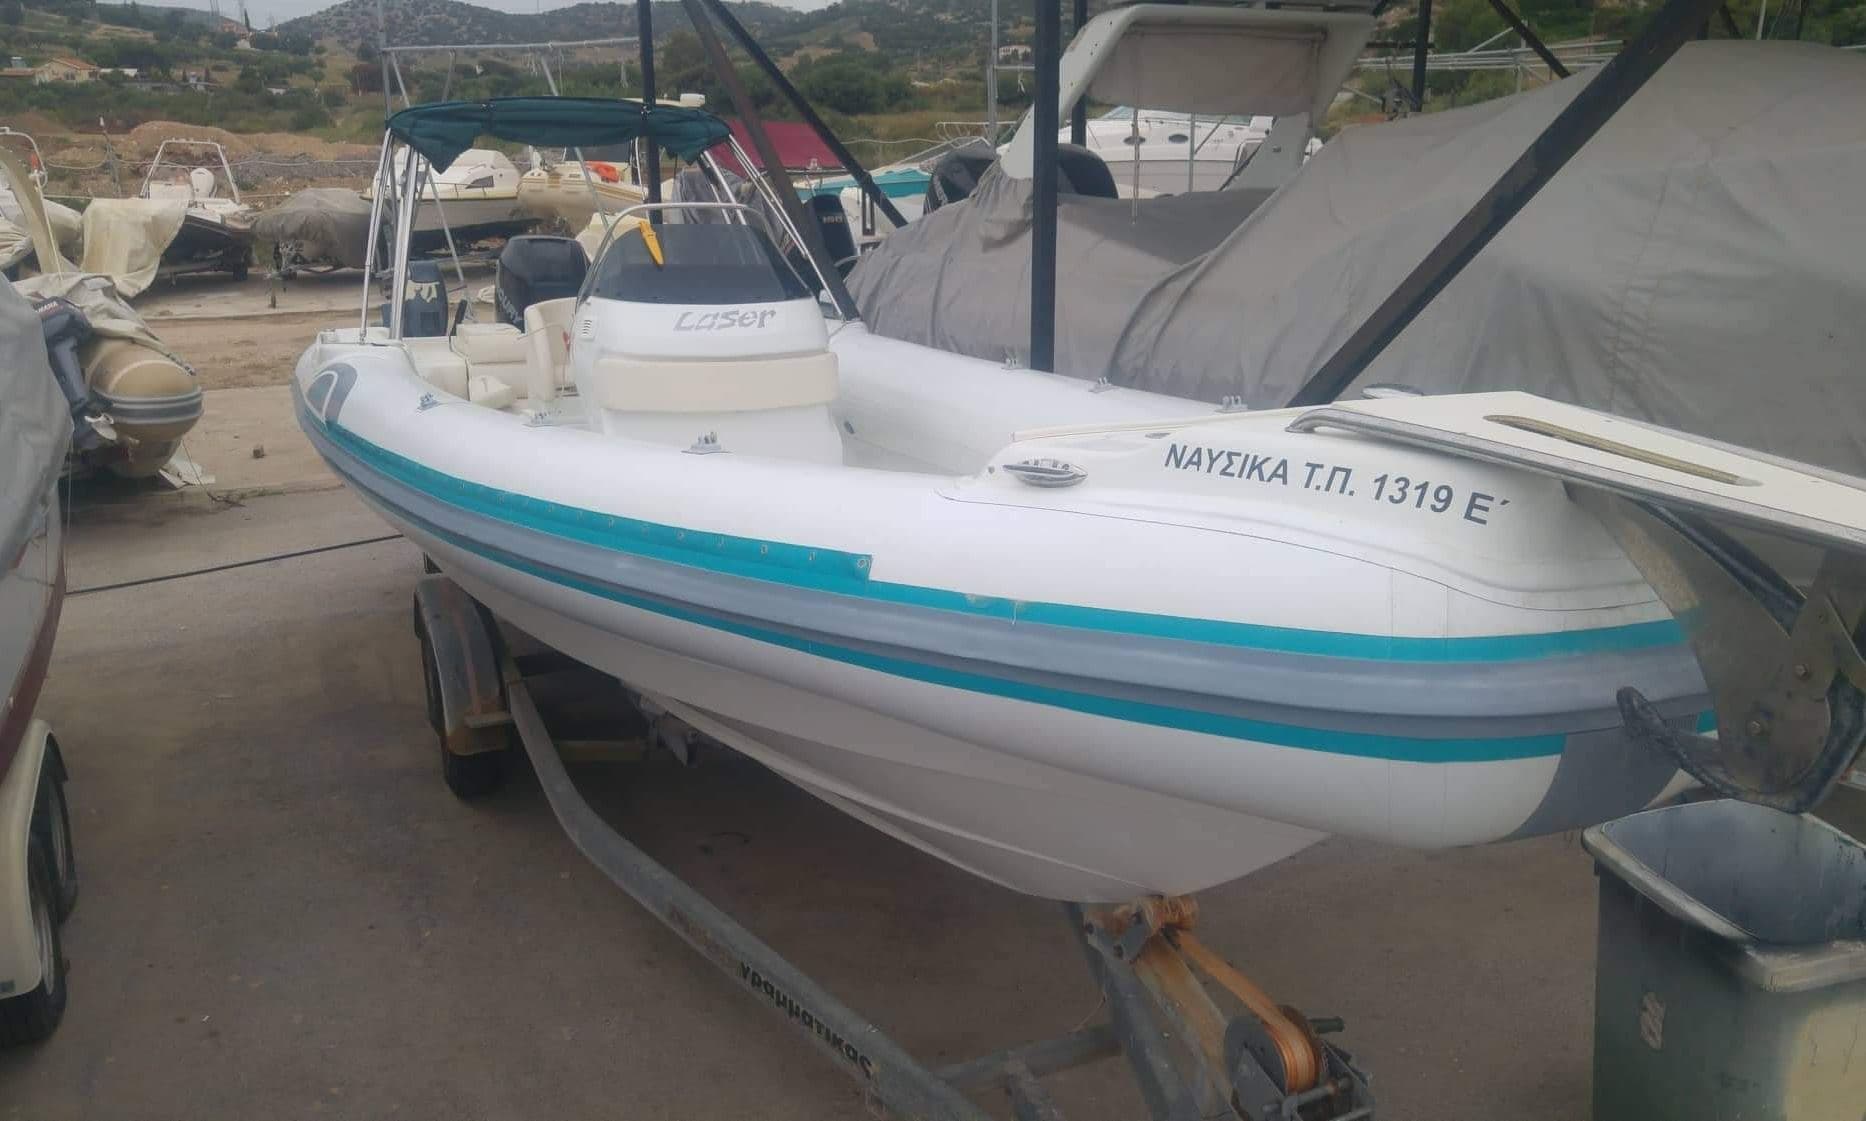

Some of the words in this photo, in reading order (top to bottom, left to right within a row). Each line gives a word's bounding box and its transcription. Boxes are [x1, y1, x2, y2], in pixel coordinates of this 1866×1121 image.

[673, 309, 777, 332] Laser
[1164, 443, 1288, 486] ΝΑΥΣΙΚΑ
[1303, 462, 1355, 497] Τ.Π.
[1373, 473, 1454, 513] 1319
